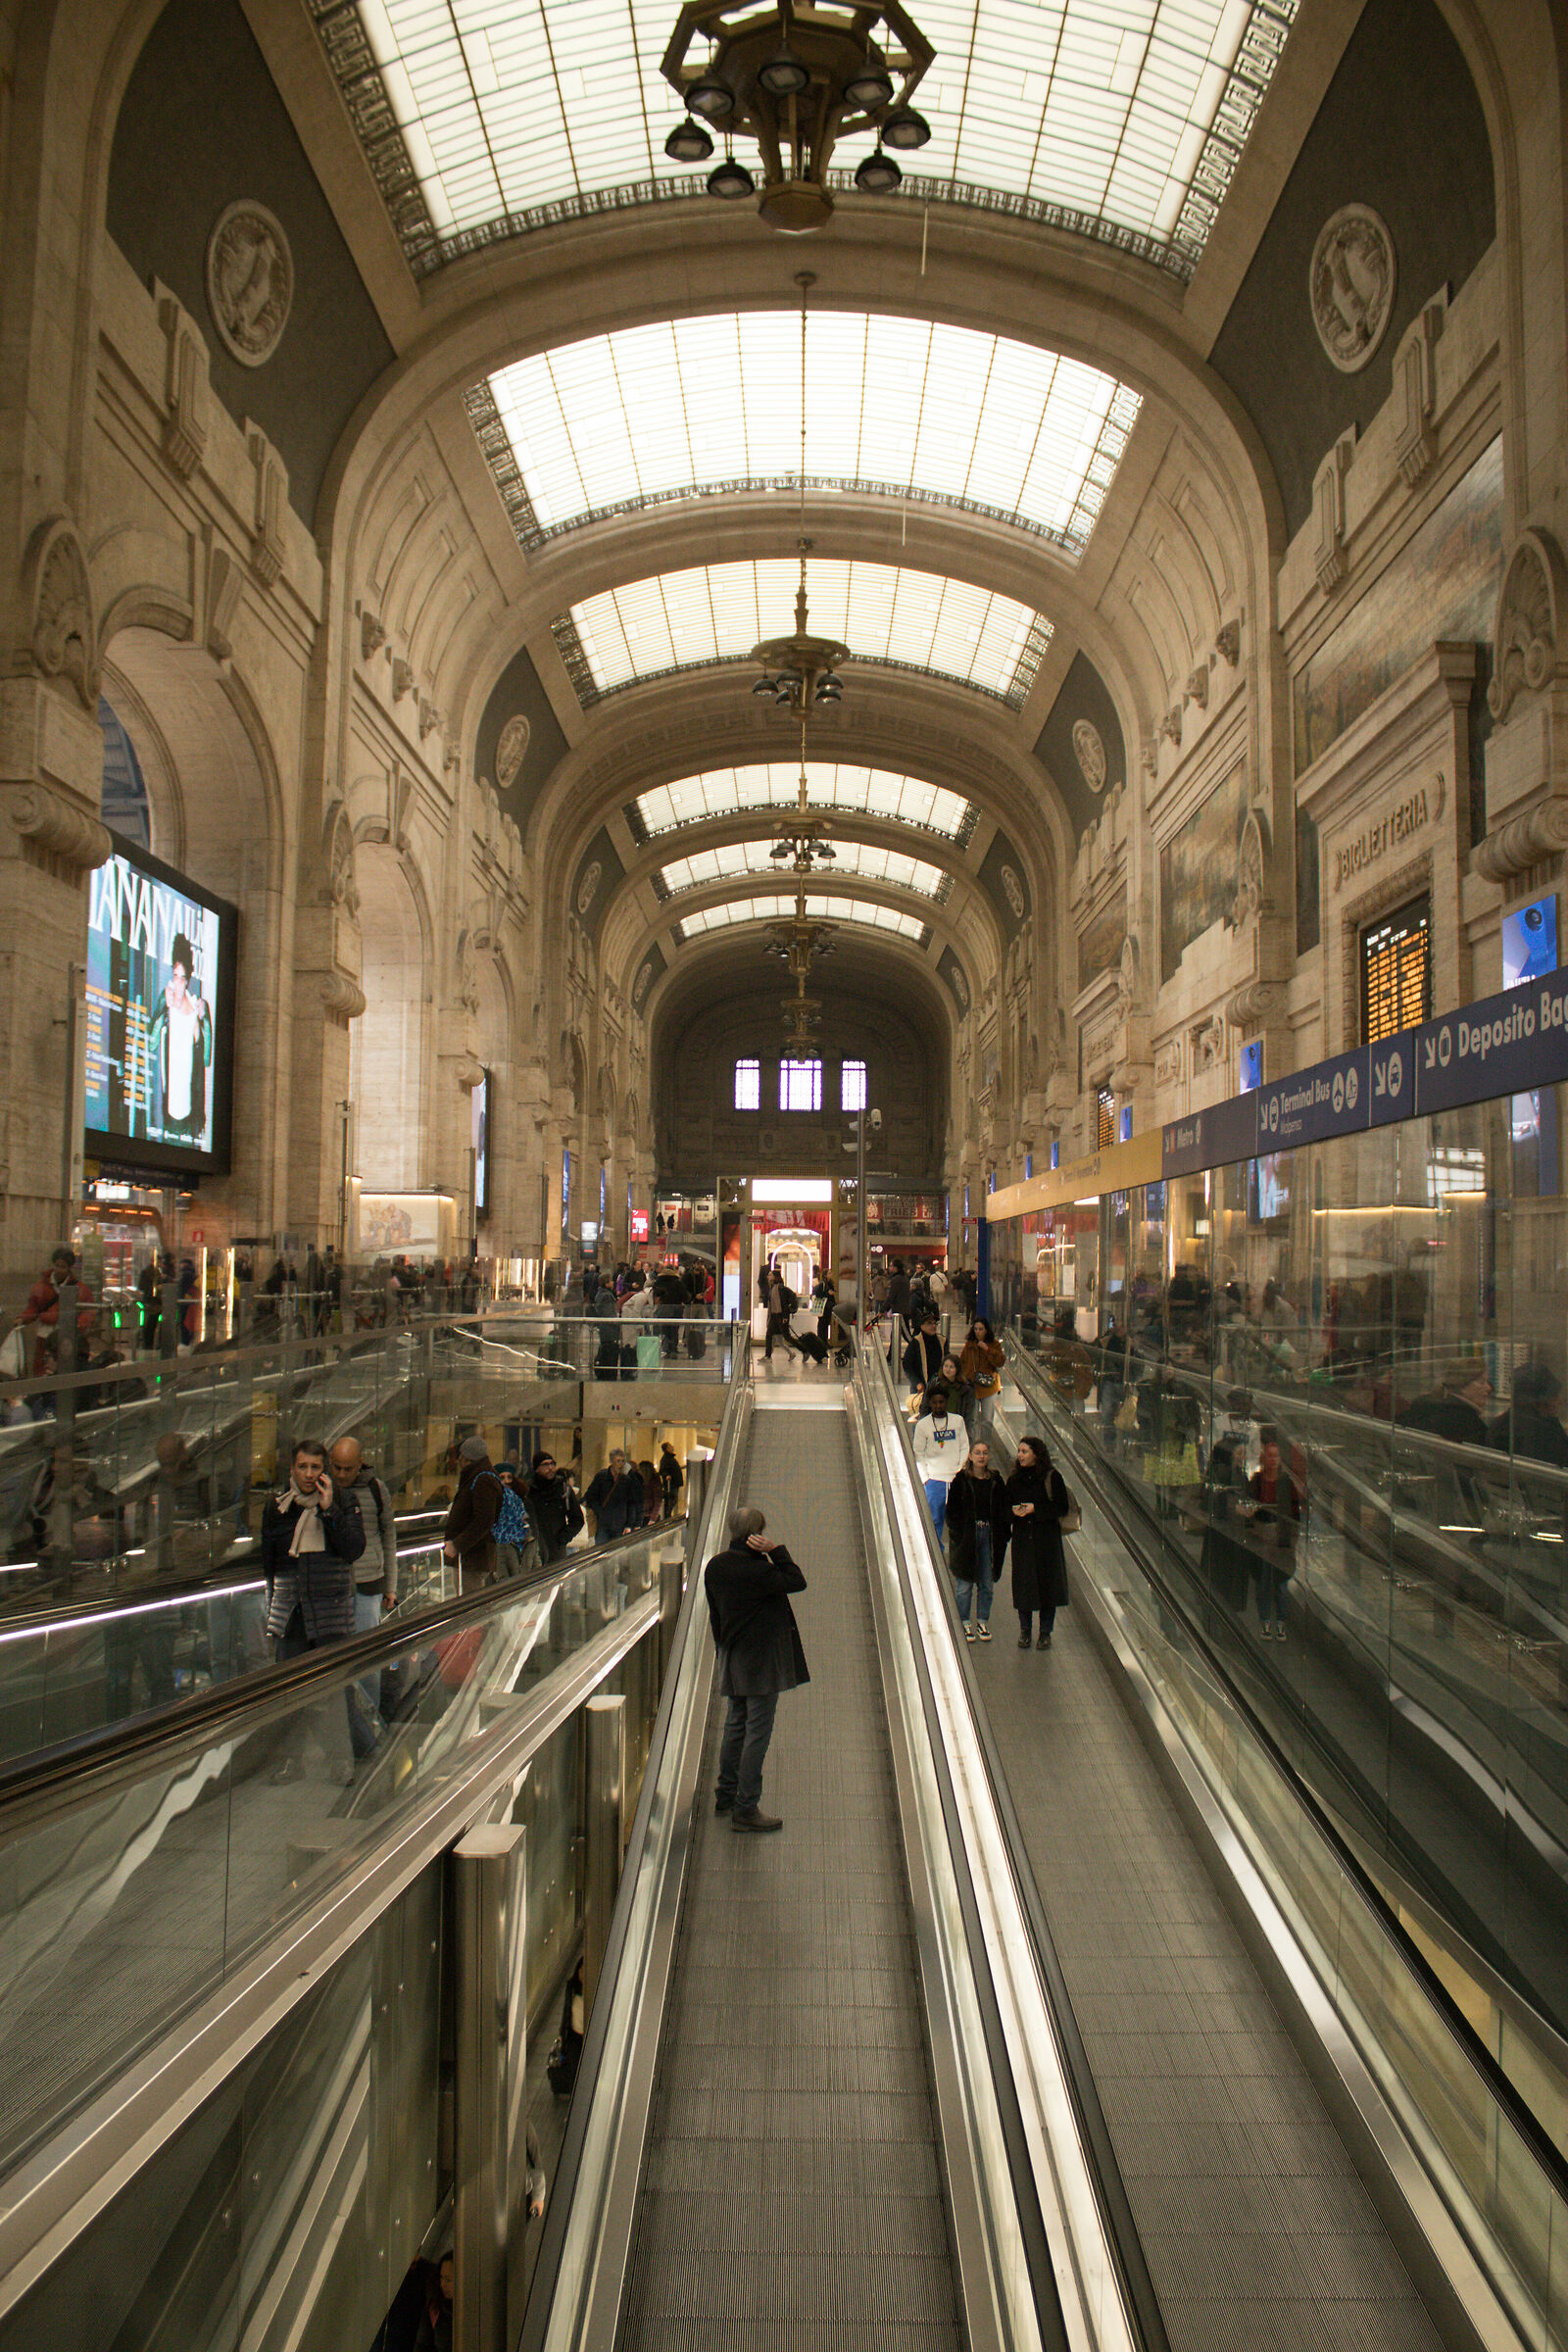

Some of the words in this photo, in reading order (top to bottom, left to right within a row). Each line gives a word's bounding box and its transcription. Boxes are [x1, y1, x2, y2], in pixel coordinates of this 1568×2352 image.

[1343, 789, 1428, 880] BIGLIETTERIA
[1458, 1003, 1536, 1060] Deposito
[1280, 1080, 1314, 1113] Terminal
[1315, 1079, 1331, 1102] Bus
[1177, 1127, 1194, 1149] Metro
